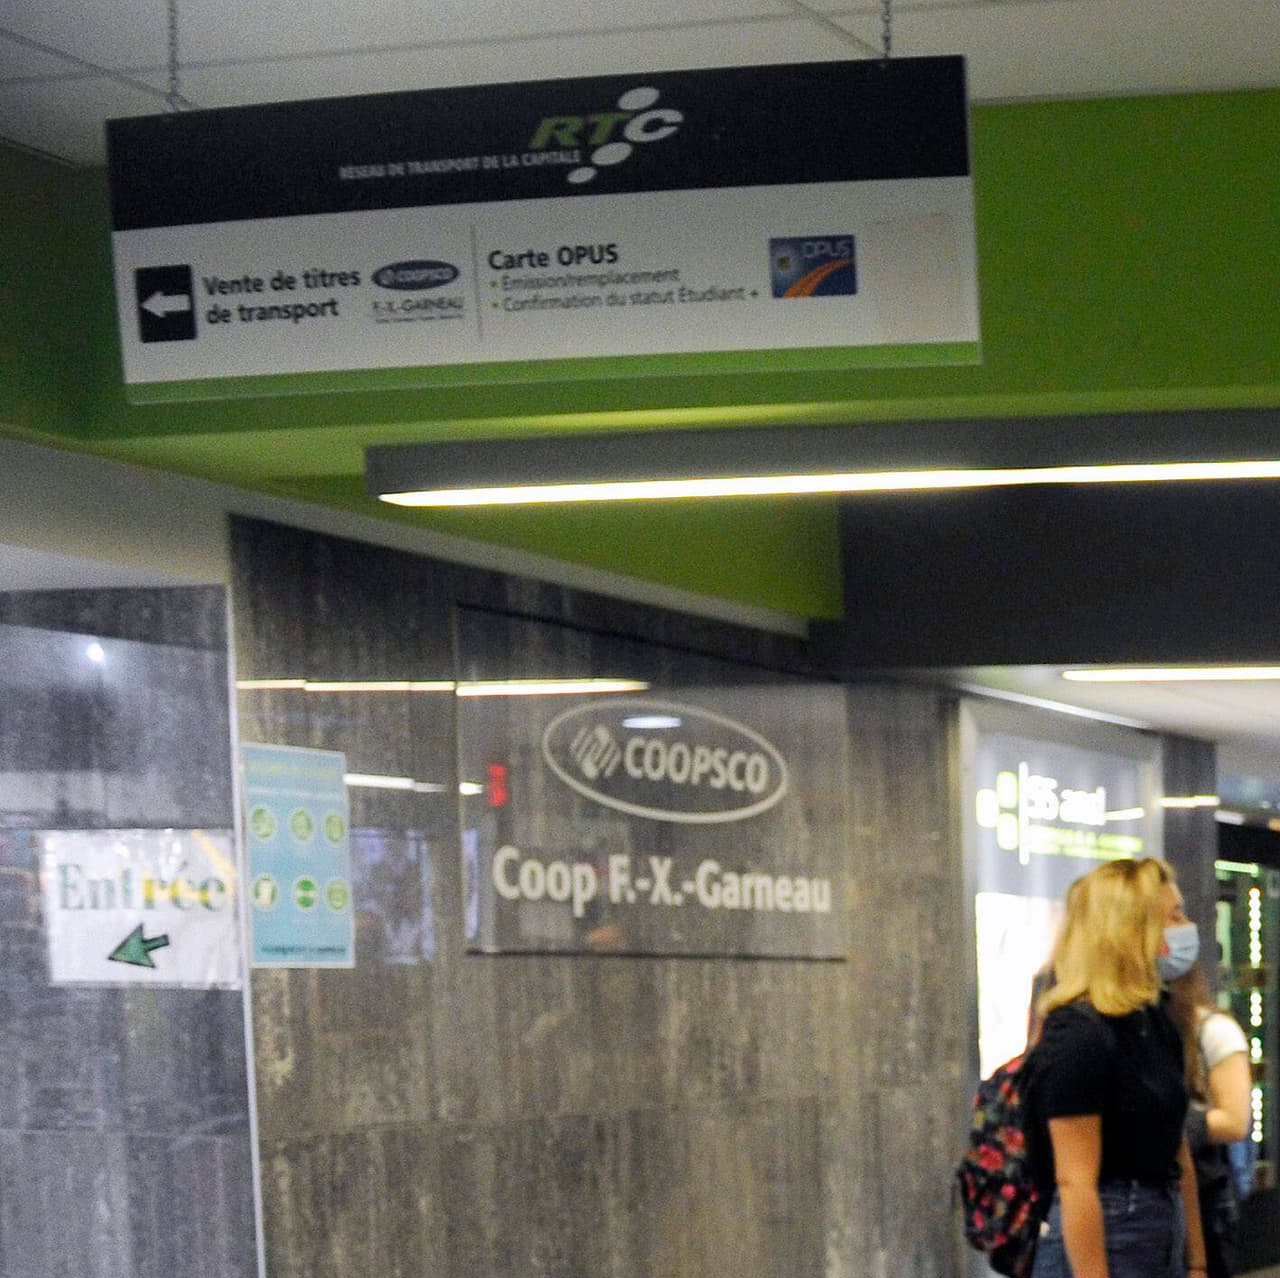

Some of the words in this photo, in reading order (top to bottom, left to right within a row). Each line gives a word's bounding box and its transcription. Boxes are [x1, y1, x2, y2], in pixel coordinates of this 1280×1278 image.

[529, 108, 684, 149] RTC
[407, 156, 481, 175] TRANSPORT
[483, 155, 500, 168] DE
[503, 153, 519, 166] LA
[522, 149, 581, 166] CAPITALE
[488, 248, 549, 270] Carte
[557, 243, 618, 266] OPUS
[804, 239, 850, 258] OPUS
[202, 274, 263, 295] Vente
[270, 270, 296, 292] de
[302, 267, 361, 289] titres
[207, 304, 231, 324] de
[238, 299, 339, 324] transport
[503, 293, 603, 313] Confirmation
[606, 291, 628, 308] du
[629, 288, 675, 307] statut
[624, 736, 769, 794] COOPSCO
[57, 860, 225, 911] Entrée
[492, 845, 598, 918] Coop
[609, 853, 832, 914] F.-X.-Garneau
